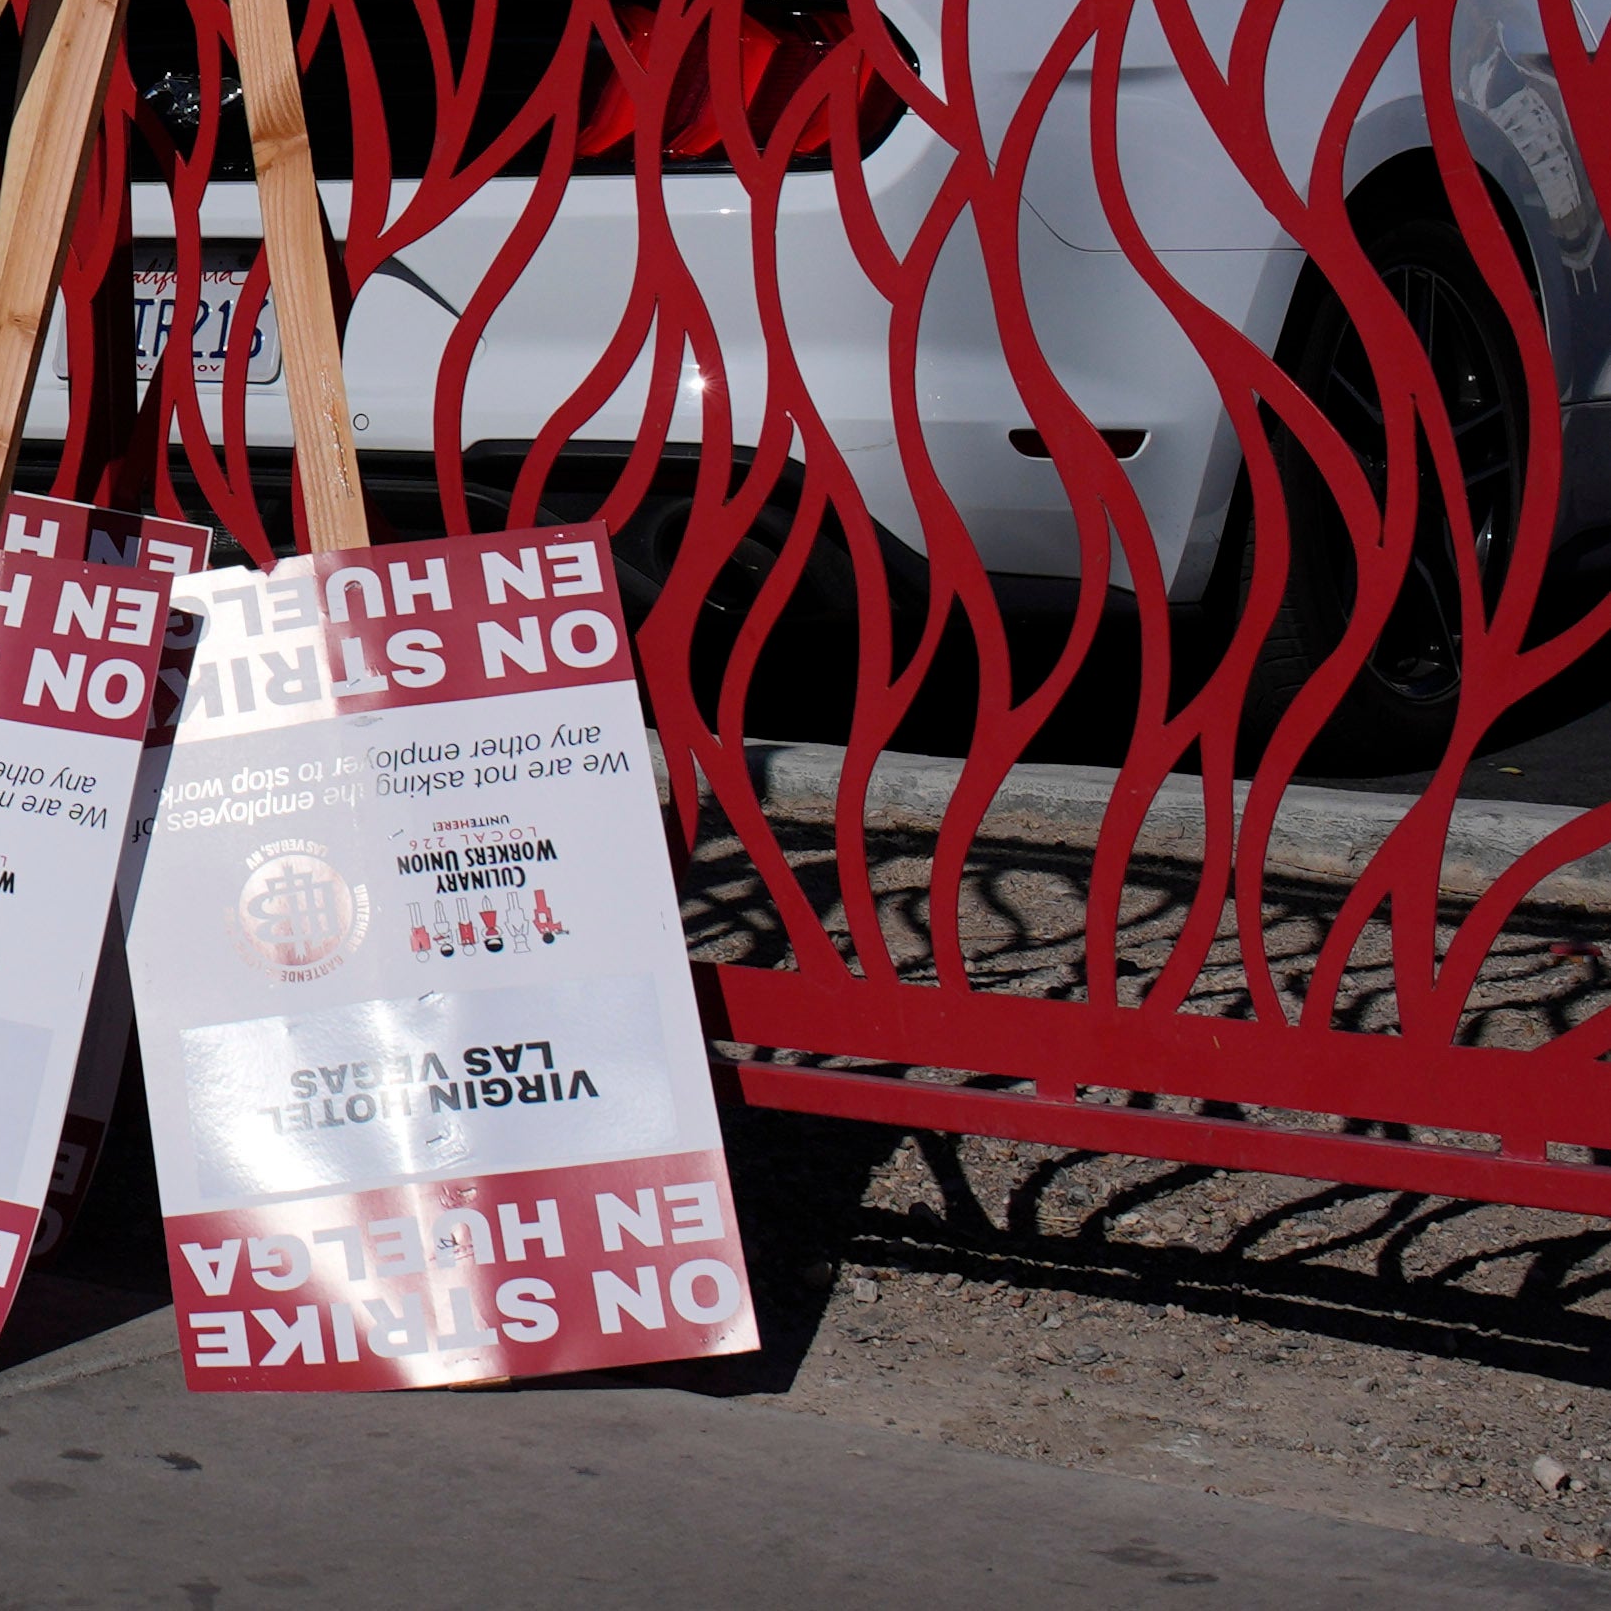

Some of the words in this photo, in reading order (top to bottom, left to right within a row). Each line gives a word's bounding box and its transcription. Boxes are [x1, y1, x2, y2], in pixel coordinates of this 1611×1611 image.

[480, 540, 603, 604] EN
[52, 580, 159, 646] EN
[163, 558, 452, 642] HUELG
[476, 609, 618, 679] ON
[22, 647, 145, 719] ON
[150, 629, 446, 726] STRIK
[469, 733, 541, 759] other
[550, 723, 601, 748] any
[296, 759, 325, 787] to
[474, 763, 516, 788] not
[527, 757, 572, 779] are
[582, 750, 629, 774] We
[49, 766, 96, 793] any
[229, 759, 294, 799] stop
[379, 769, 465, 798] asking
[20, 794, 62, 816] are
[68, 802, 107, 829] We
[165, 787, 319, 840] employees
[432, 813, 510, 832] UNITEHERE!
[459, 825, 537, 845] LOCAL
[408, 835, 446, 851] 226
[463, 838, 557, 867] WORKERS
[396, 849, 459, 874] UNION
[436, 865, 526, 894] CULINARY
[462, 1040, 554, 1077] LAS
[291, 1052, 449, 1100] VEGAS
[442, 1069, 599, 1111] VIRGIN
[595, 1181, 727, 1251] EN
[179, 1198, 565, 1296] HUELGA
[592, 1259, 742, 1334] ON
[190, 1277, 560, 1367] STRIKE
